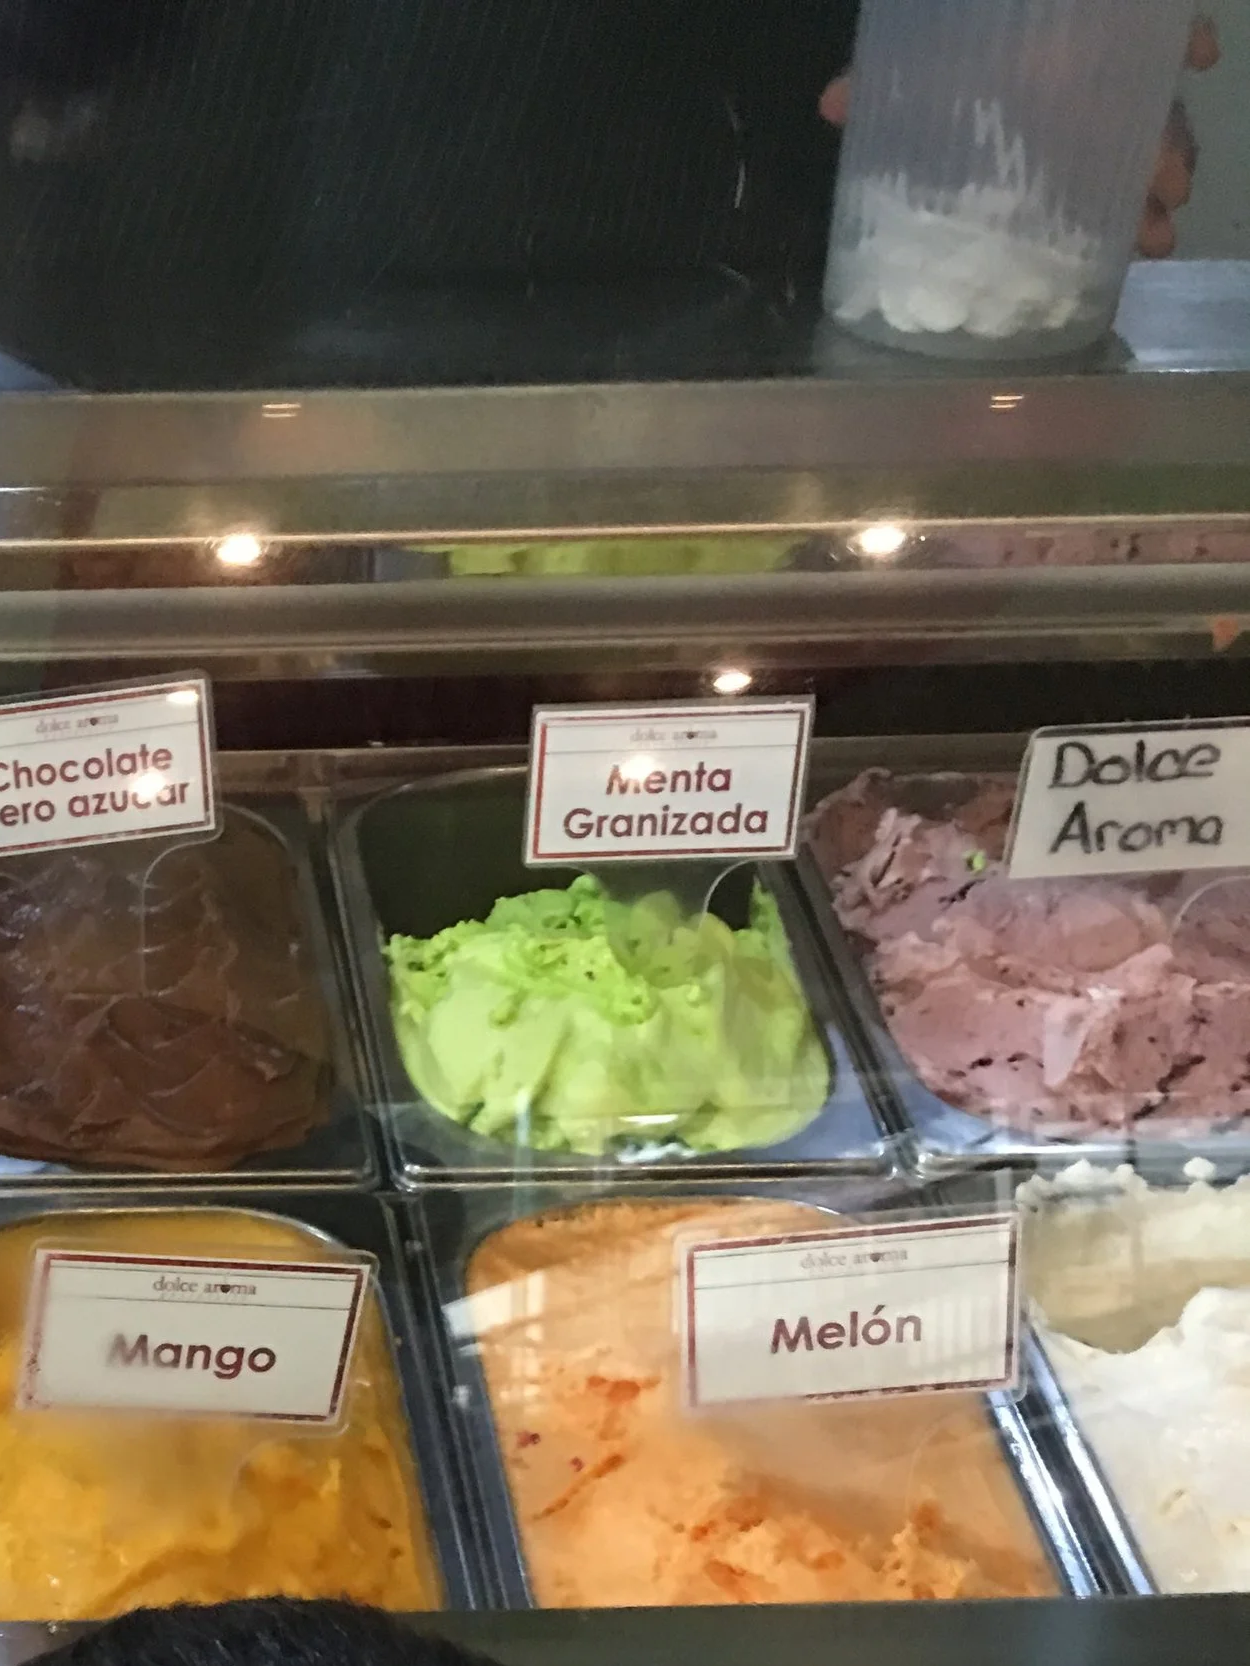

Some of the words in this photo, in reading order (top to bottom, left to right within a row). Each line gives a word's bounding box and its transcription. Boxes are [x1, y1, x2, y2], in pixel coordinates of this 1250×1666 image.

[606, 761, 732, 795] Menta
[1048, 739, 1221, 789] Dolce
[563, 803, 768, 839] Granizada
[1049, 801, 1223, 855] Aroma
[153, 1276, 199, 1293] dolce
[771, 1305, 922, 1354] Melón
[107, 1333, 277, 1380] Mango
